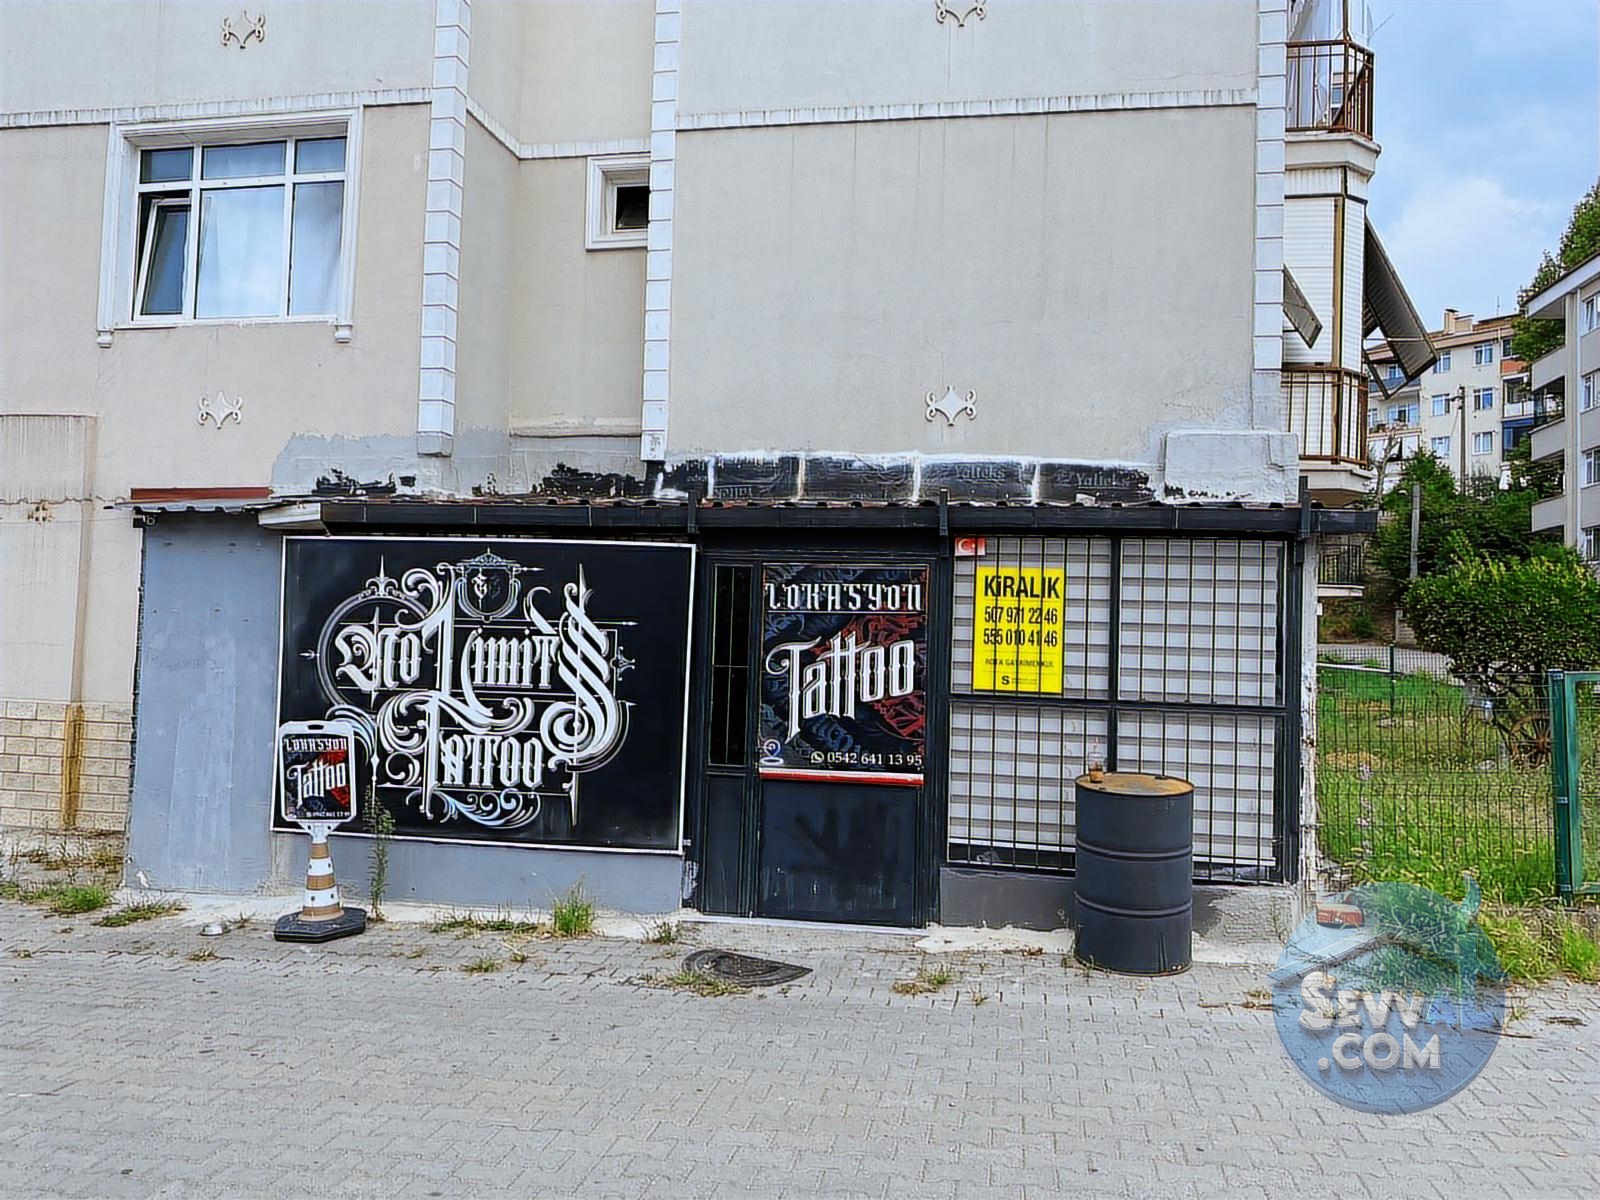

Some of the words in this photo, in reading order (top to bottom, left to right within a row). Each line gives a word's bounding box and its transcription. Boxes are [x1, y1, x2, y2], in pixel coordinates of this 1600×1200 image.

[984, 606, 1004, 624] 507
[1006, 606, 1025, 624] 971
[1028, 607, 1042, 625] 22
[1043, 608, 1058, 625] 46
[983, 628, 1003, 645] 555
[1027, 630, 1041, 647] 41
[1043, 630, 1058, 647] 46
[765, 631, 916, 744] Tattoo
[827, 752, 858, 764] 0542
[861, 753, 883, 765] 641
[888, 754, 902, 765] 13
[907, 754, 923, 766] 95
[287, 758, 347, 809] Tattoo
